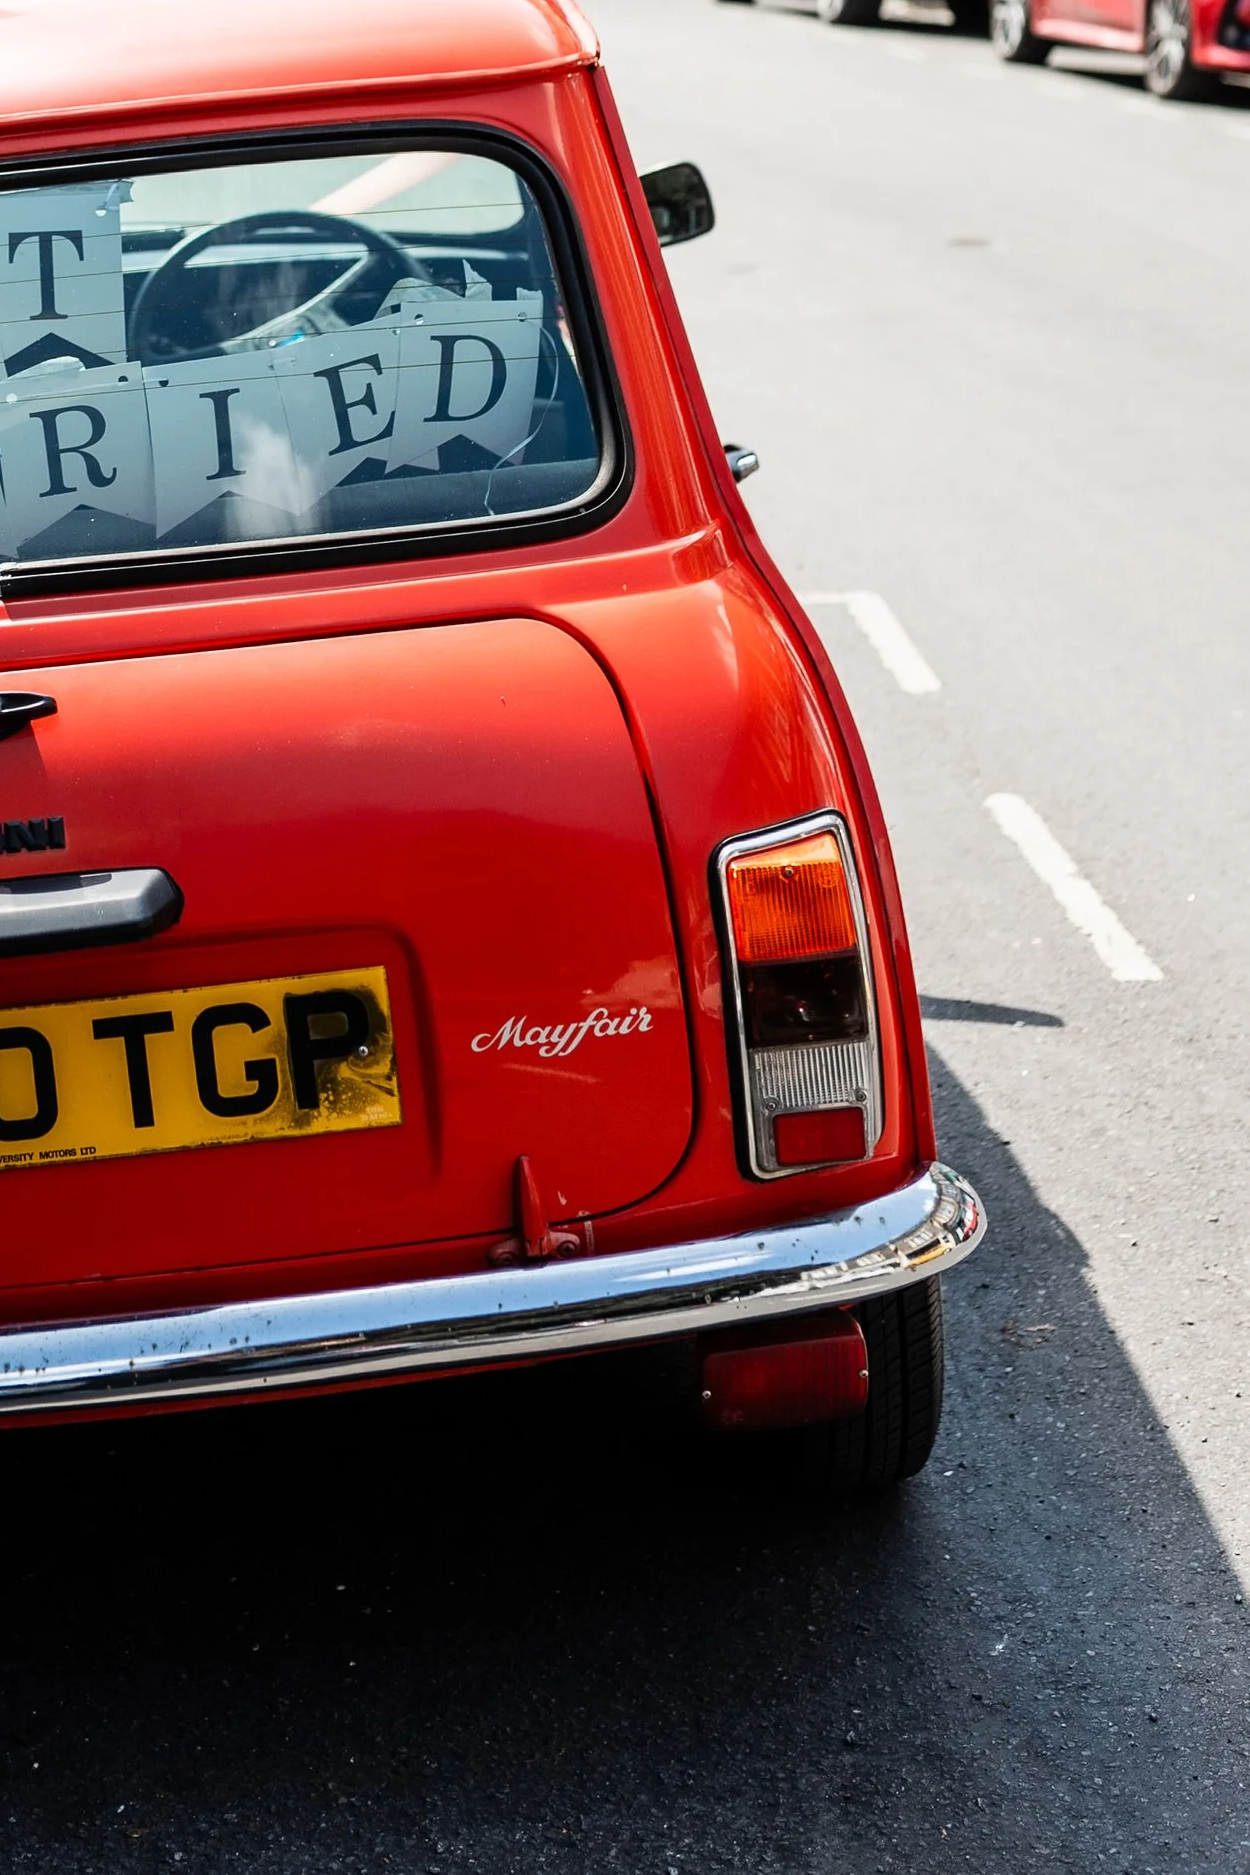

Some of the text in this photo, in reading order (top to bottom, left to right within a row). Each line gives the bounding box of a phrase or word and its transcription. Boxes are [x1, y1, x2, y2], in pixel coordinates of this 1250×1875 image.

[471, 1007, 653, 1057] Mayfair
[93, 990, 371, 1129] TGP
[39, 1148, 77, 1160] MOTORS
[80, 1146, 96, 1156] LTD
